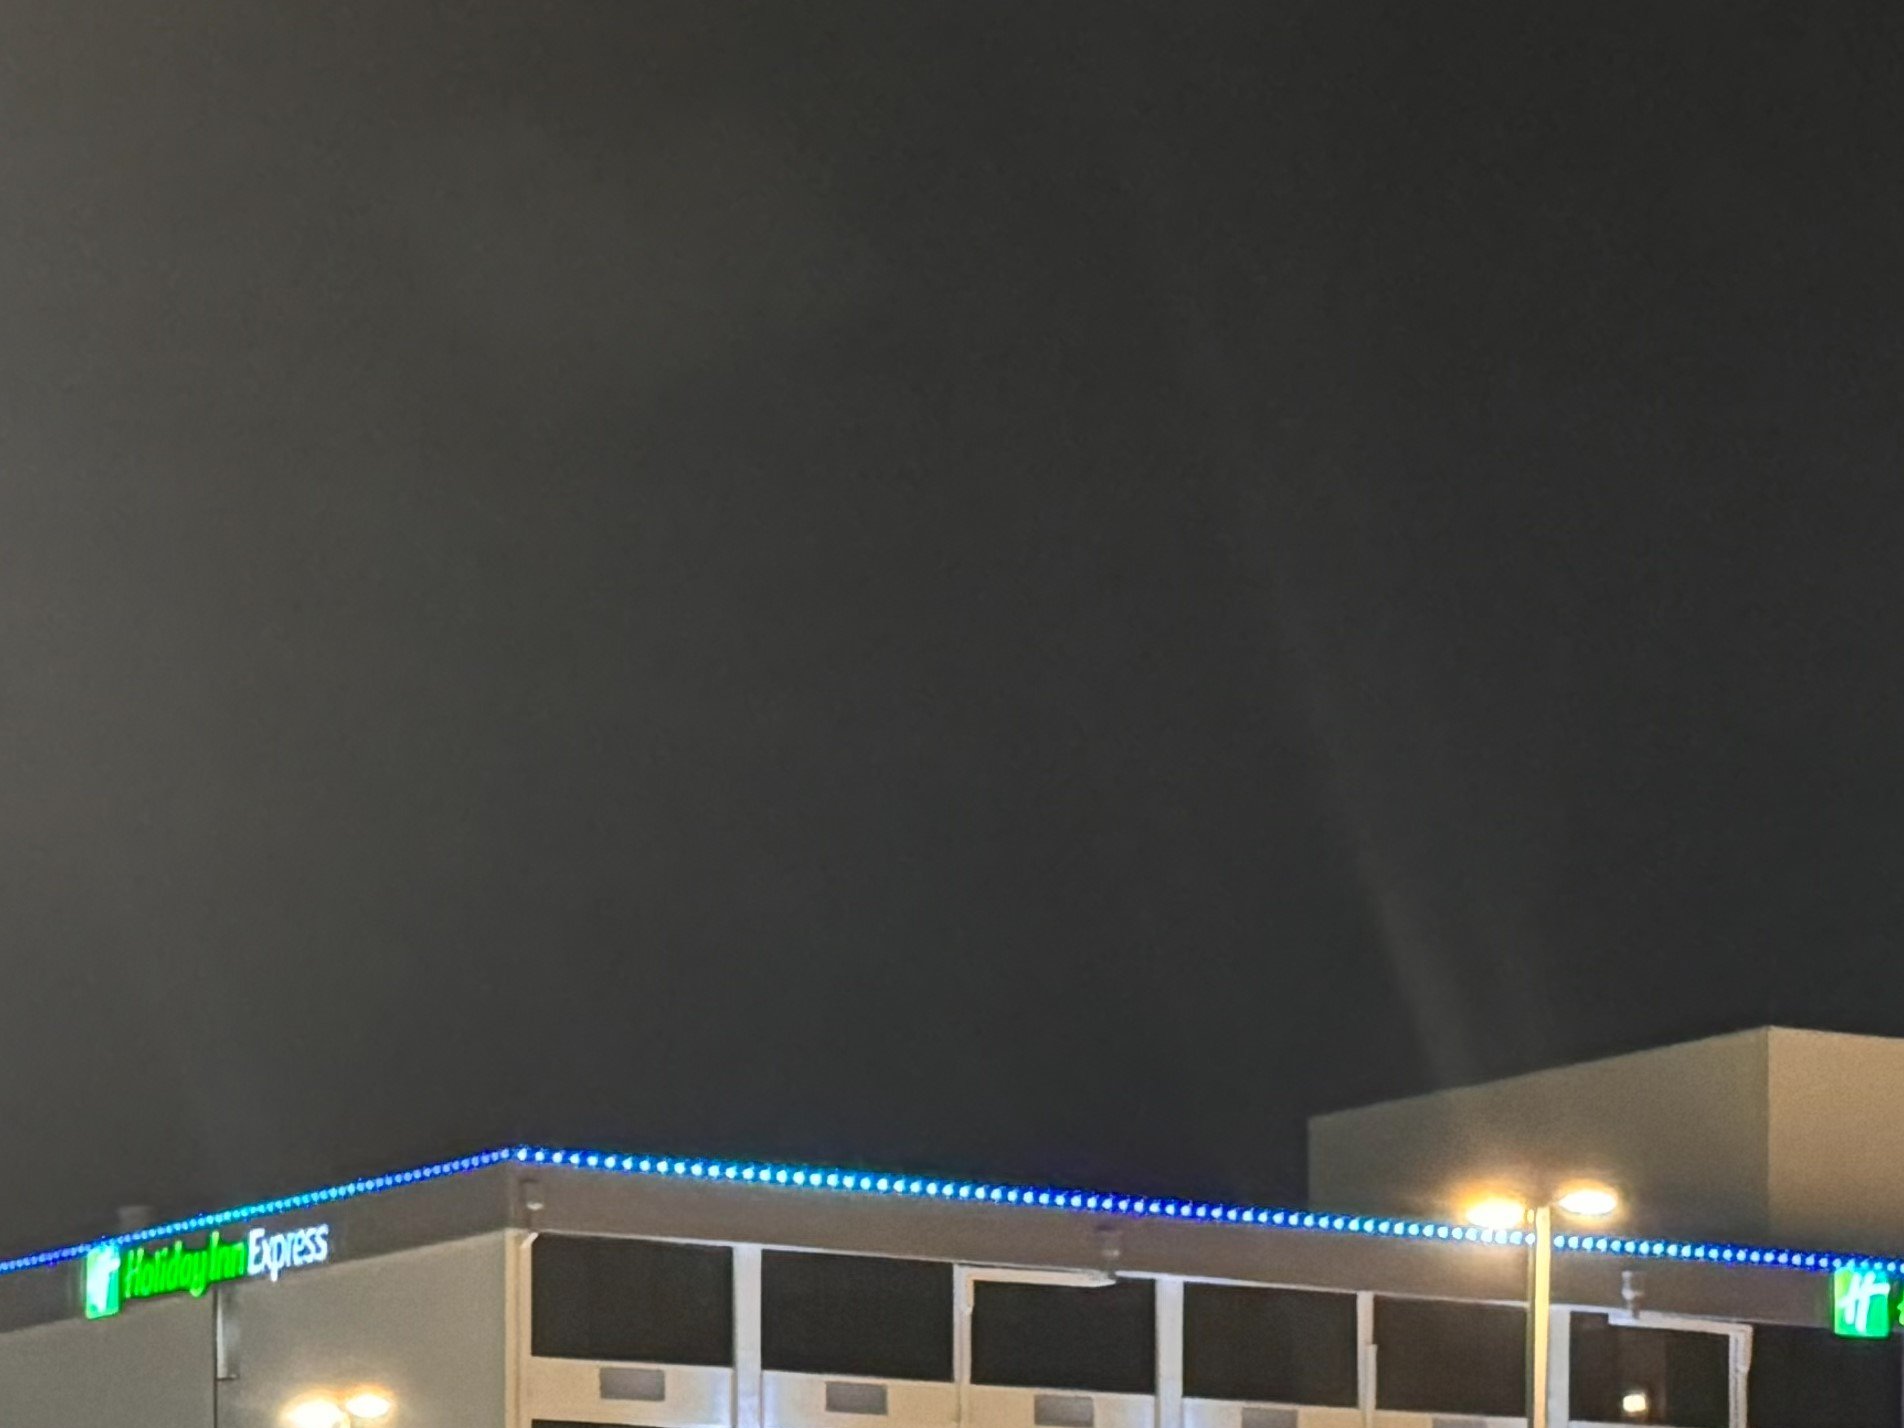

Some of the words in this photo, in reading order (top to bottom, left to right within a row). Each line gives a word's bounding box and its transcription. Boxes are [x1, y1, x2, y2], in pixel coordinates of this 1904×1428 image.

[125, 1240, 207, 1297] Holiday
[210, 1230, 244, 1280] Inn
[247, 1224, 329, 1282] Express
